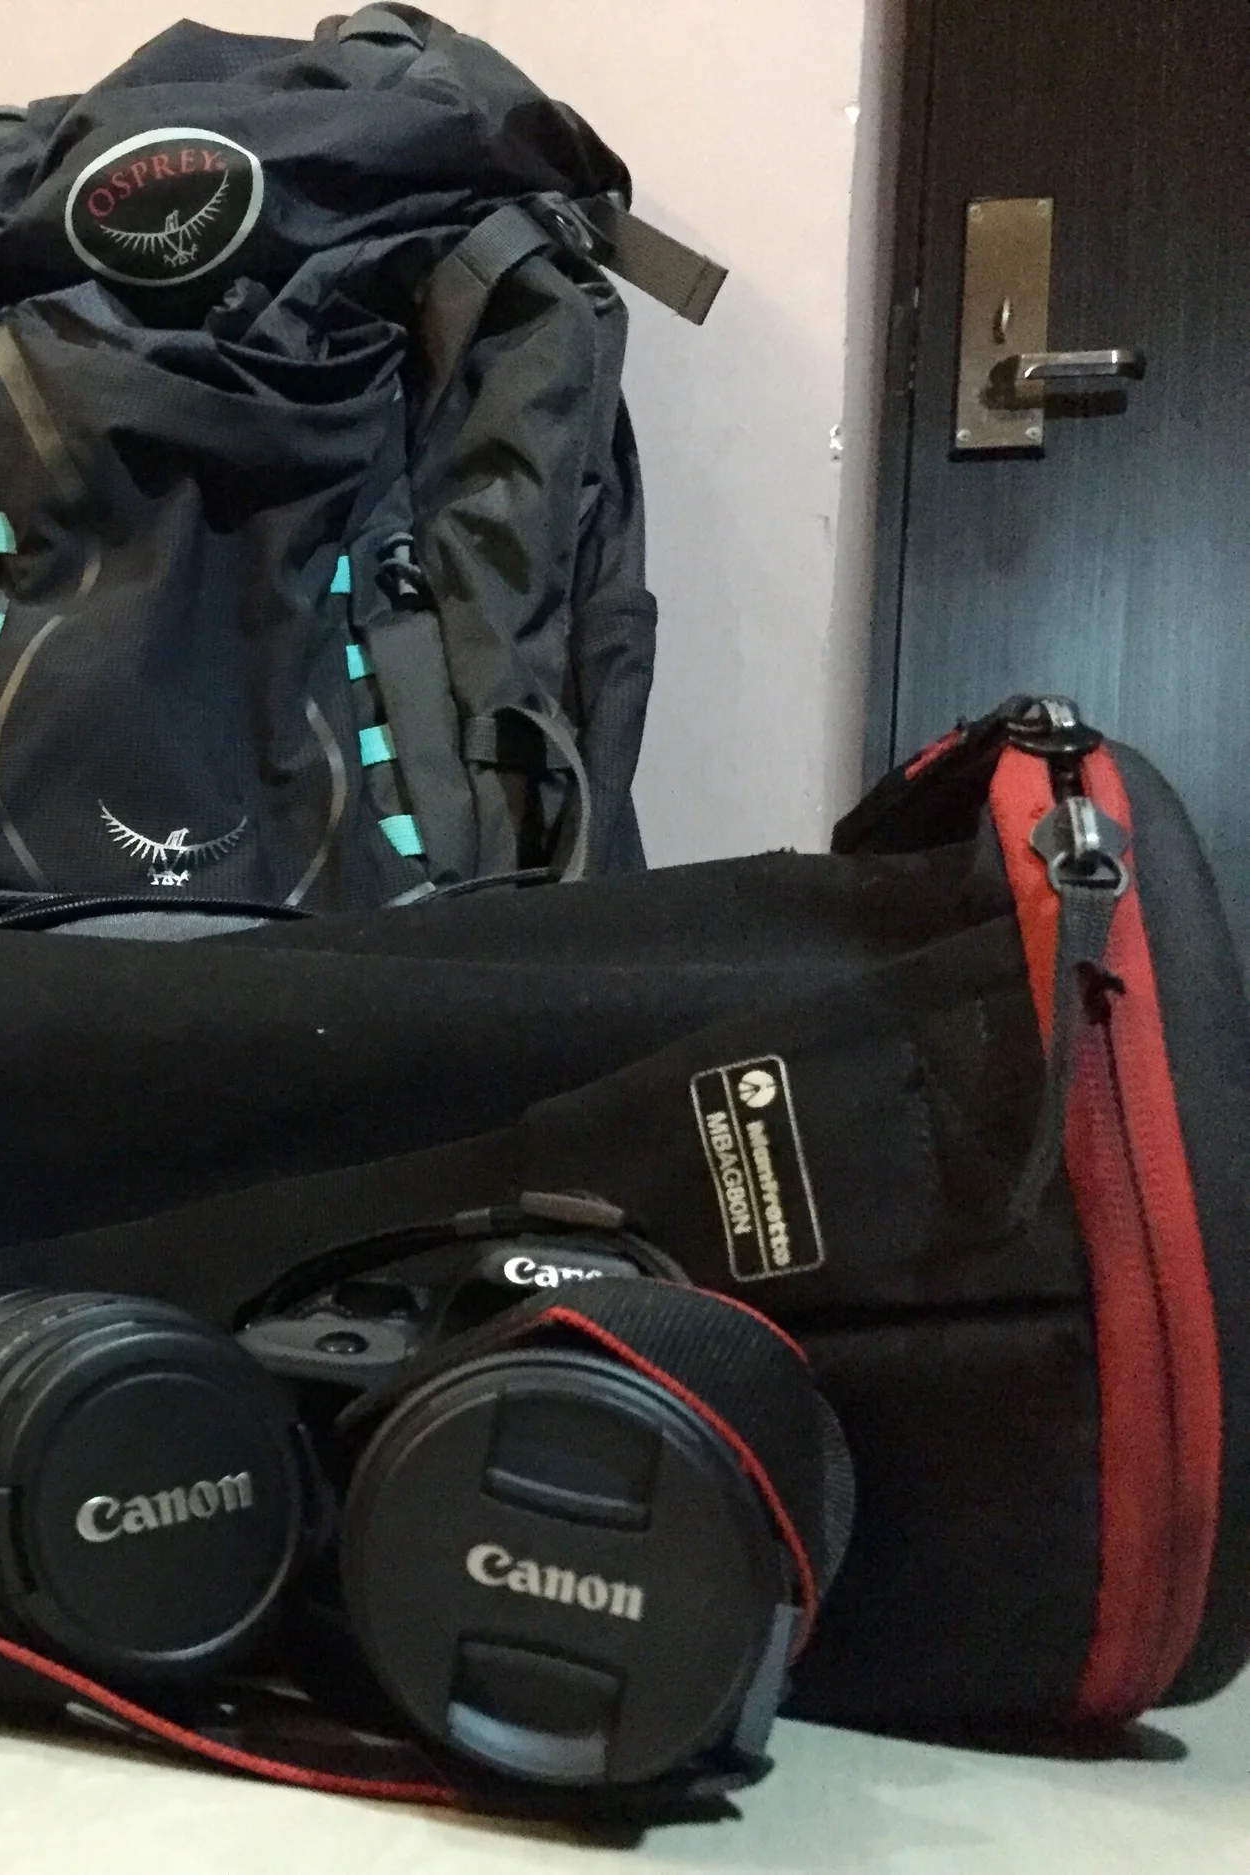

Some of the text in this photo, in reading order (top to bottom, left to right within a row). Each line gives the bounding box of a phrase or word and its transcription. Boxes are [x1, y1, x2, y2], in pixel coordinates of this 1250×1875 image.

[87, 149, 223, 218] OSPREY
[745, 1119, 792, 1268] Manfrotto
[75, 1470, 254, 1543] Canon
[466, 1542, 647, 1623] Canon
